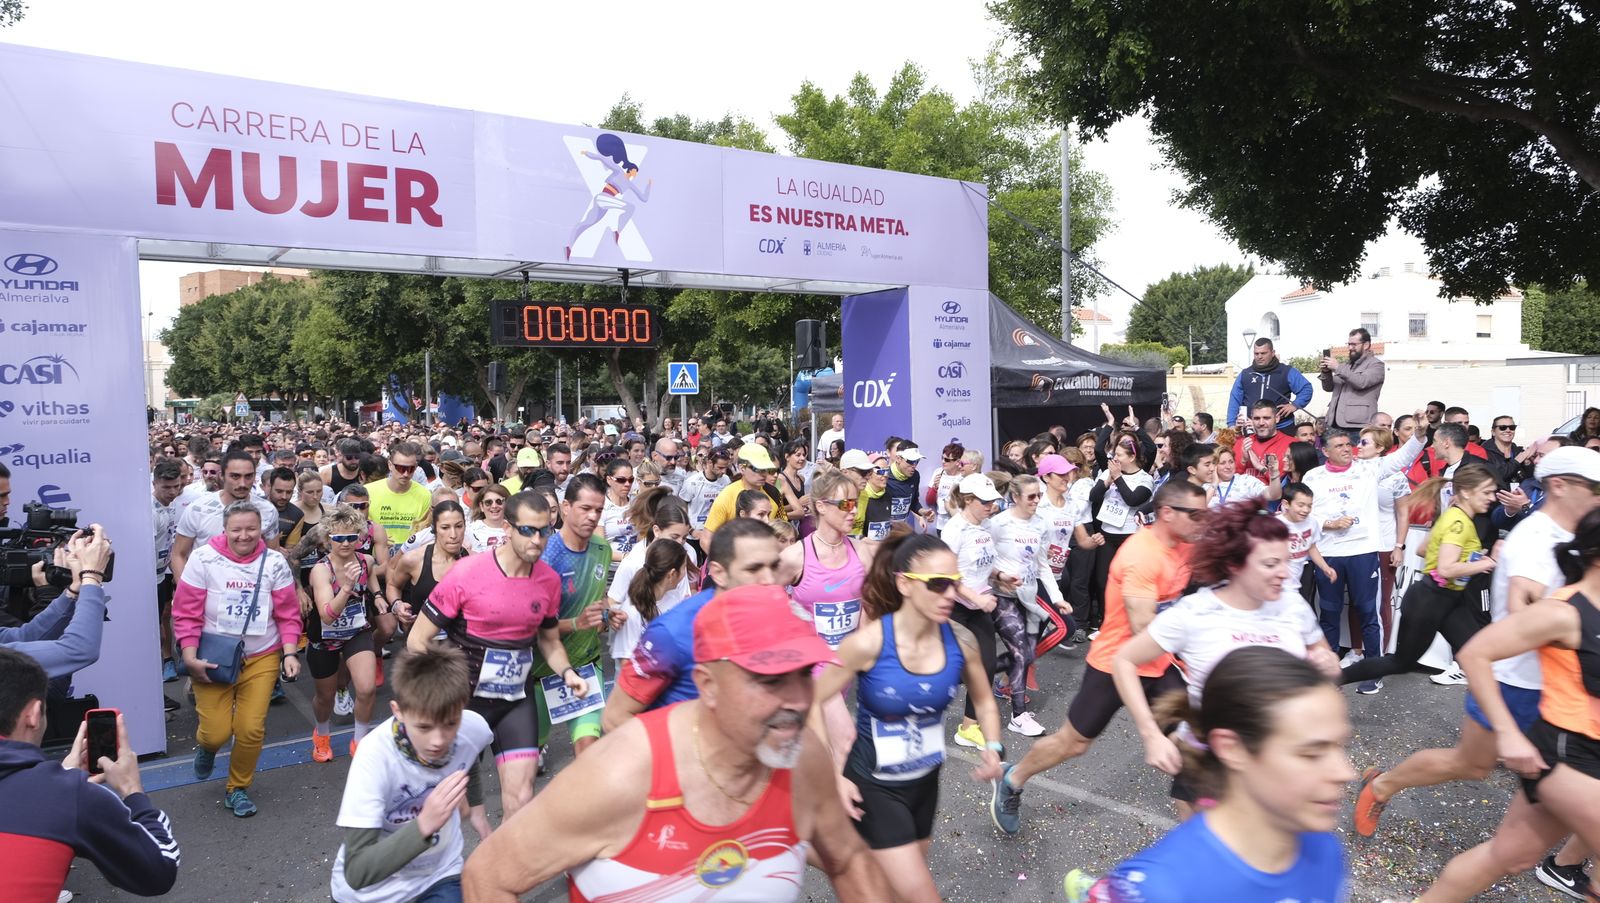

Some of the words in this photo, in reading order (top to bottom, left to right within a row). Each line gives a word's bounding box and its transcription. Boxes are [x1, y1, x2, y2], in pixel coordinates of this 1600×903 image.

[171, 102, 331, 145] CARRERA
[341, 122, 380, 150] DE
[391, 129, 426, 156] LA
[154, 141, 443, 227] MUJER
[777, 177, 798, 196] LA
[803, 180, 885, 206] IGUALDAD
[750, 204, 772, 223] ES
[777, 207, 857, 232] NUESTRA
[860, 216, 909, 236] META.
[759, 237, 787, 254] CDX
[0, 279, 79, 291] YUNDAI
[11, 320, 87, 335] cajamar
[523, 305, 650, 342] 00:00:00
[944, 339, 971, 349] cajamar
[0, 364, 62, 384] CASI
[938, 365, 962, 378] CASI
[853, 374, 896, 408] CDX
[946, 388, 971, 397] vithas
[21, 401, 90, 416] vithas
[942, 416, 971, 428] aqualia
[12, 448, 91, 469] aqualia
[828, 614, 851, 629] 115
